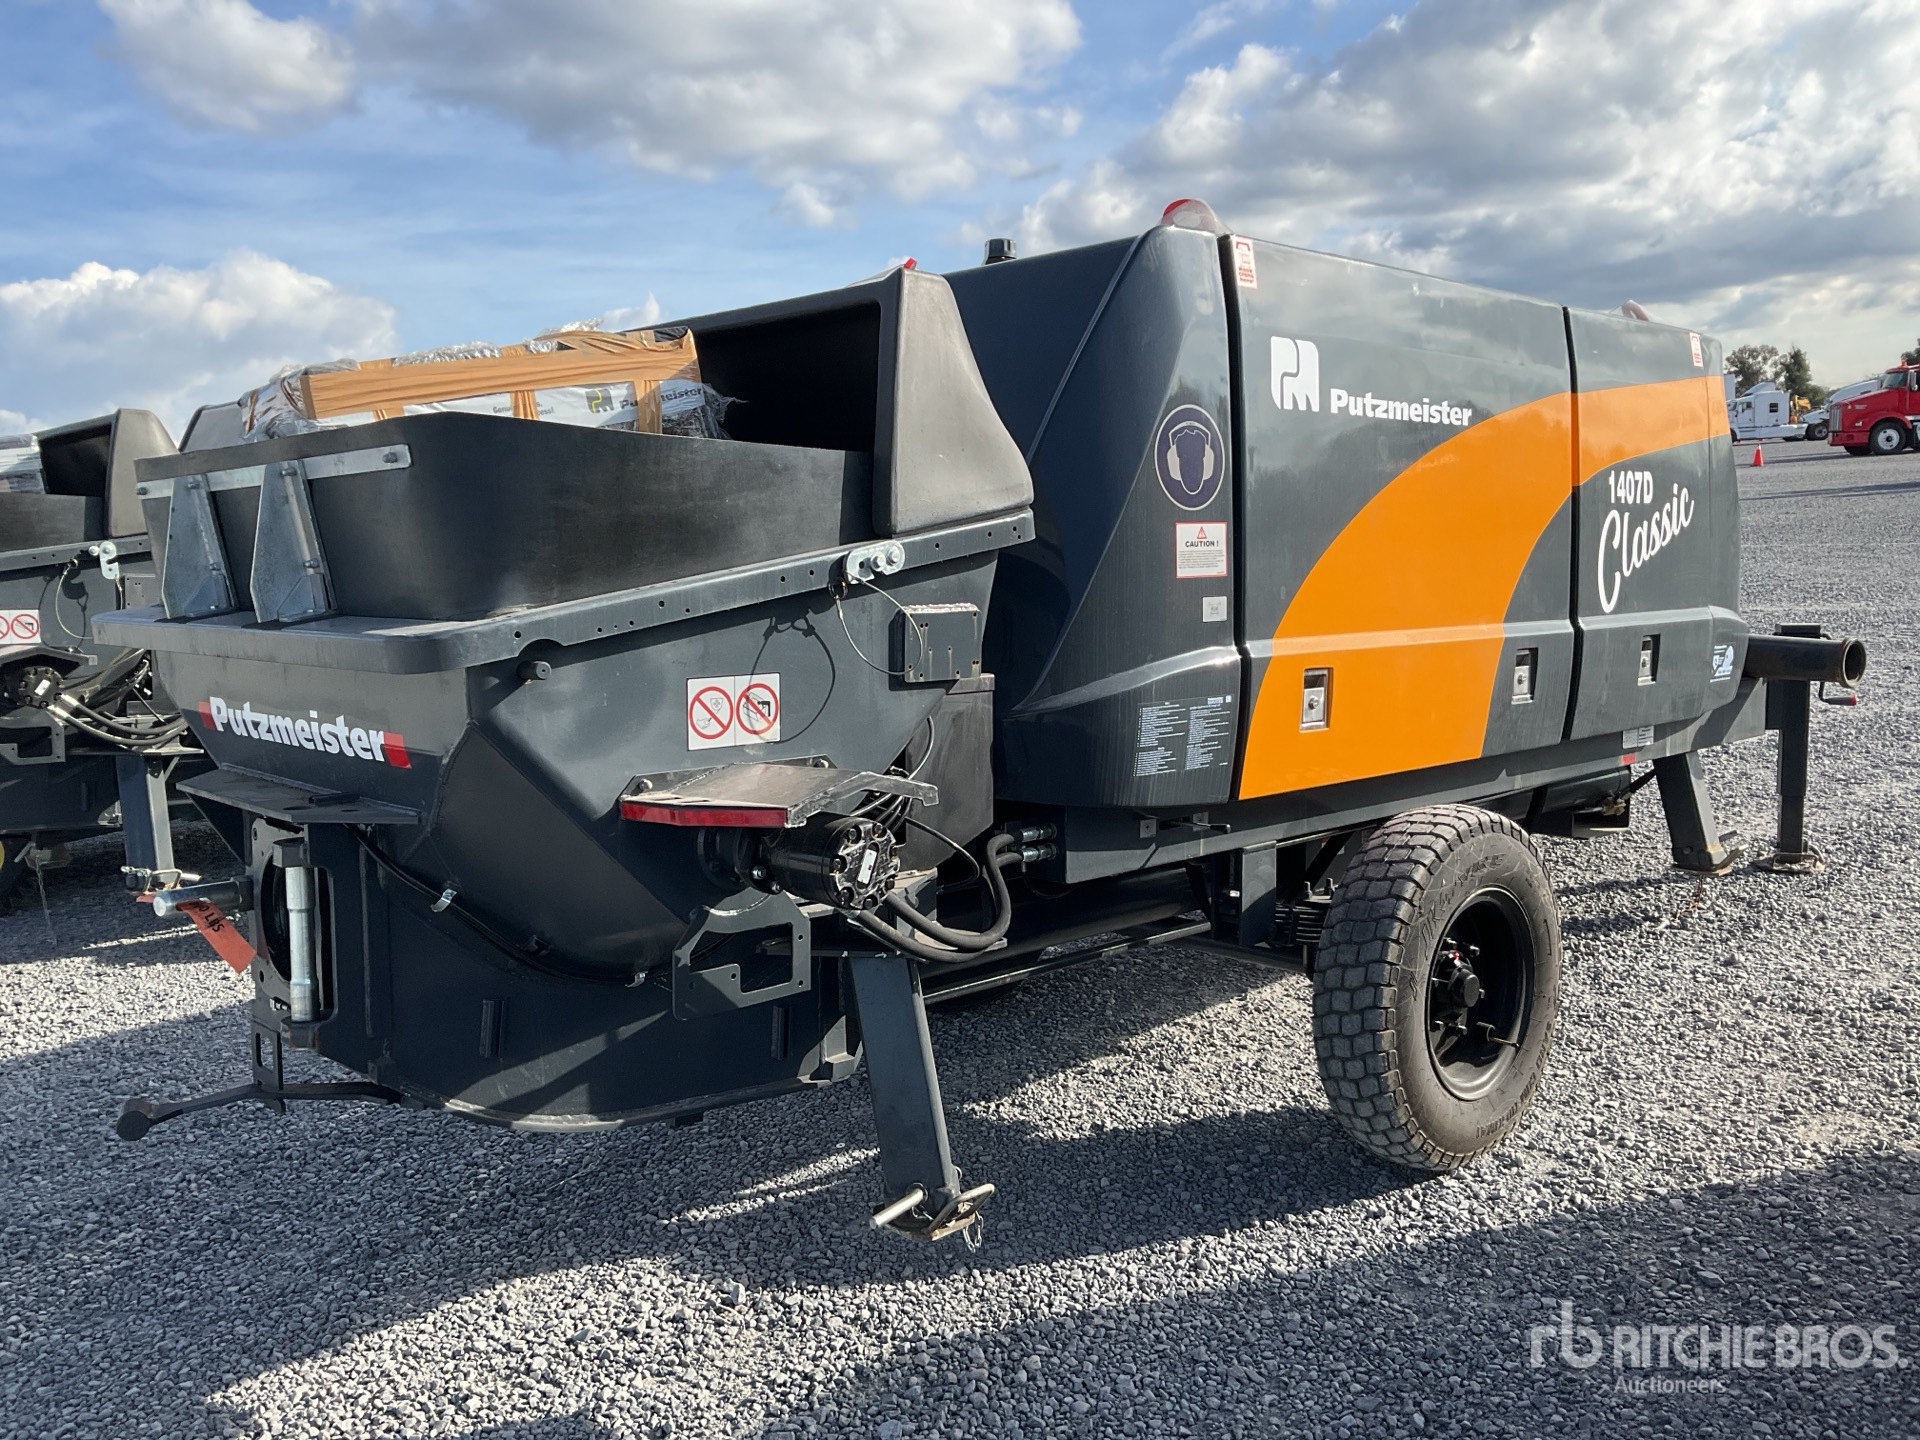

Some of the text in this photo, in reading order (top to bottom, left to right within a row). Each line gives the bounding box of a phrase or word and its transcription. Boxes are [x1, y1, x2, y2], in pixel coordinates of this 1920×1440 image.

[1330, 388, 1473, 427] Putzmeister
[1608, 470, 1653, 505] 1407D
[1185, 540, 1215, 548] CAUTION
[1597, 482, 1695, 614] Classic
[209, 696, 385, 762] Putzmeister
[205, 911, 225, 933] LBS
